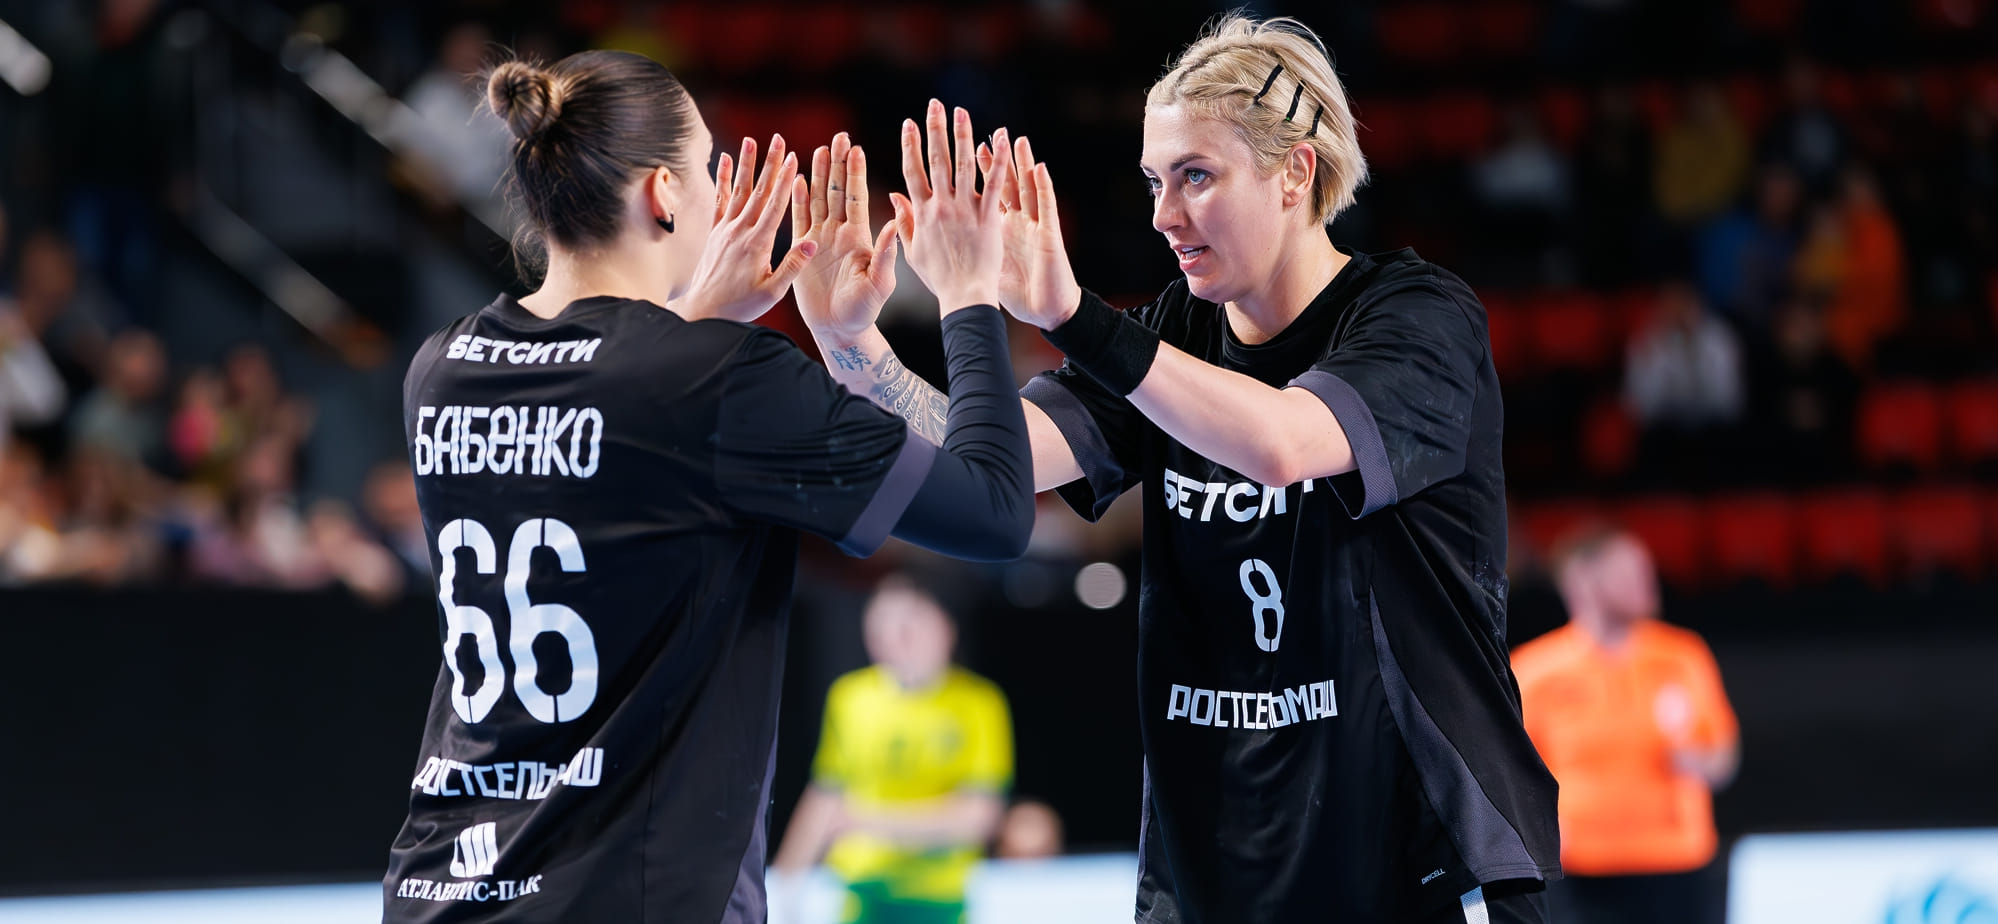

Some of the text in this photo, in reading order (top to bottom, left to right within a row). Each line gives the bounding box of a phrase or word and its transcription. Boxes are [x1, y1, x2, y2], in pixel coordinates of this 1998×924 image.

[446, 334, 602, 365] БЕТСИТИ
[437, 518, 599, 724] 66
[1239, 558, 1285, 652] 8
[1166, 679, 1338, 730] РОСТСЕЬМАШ
